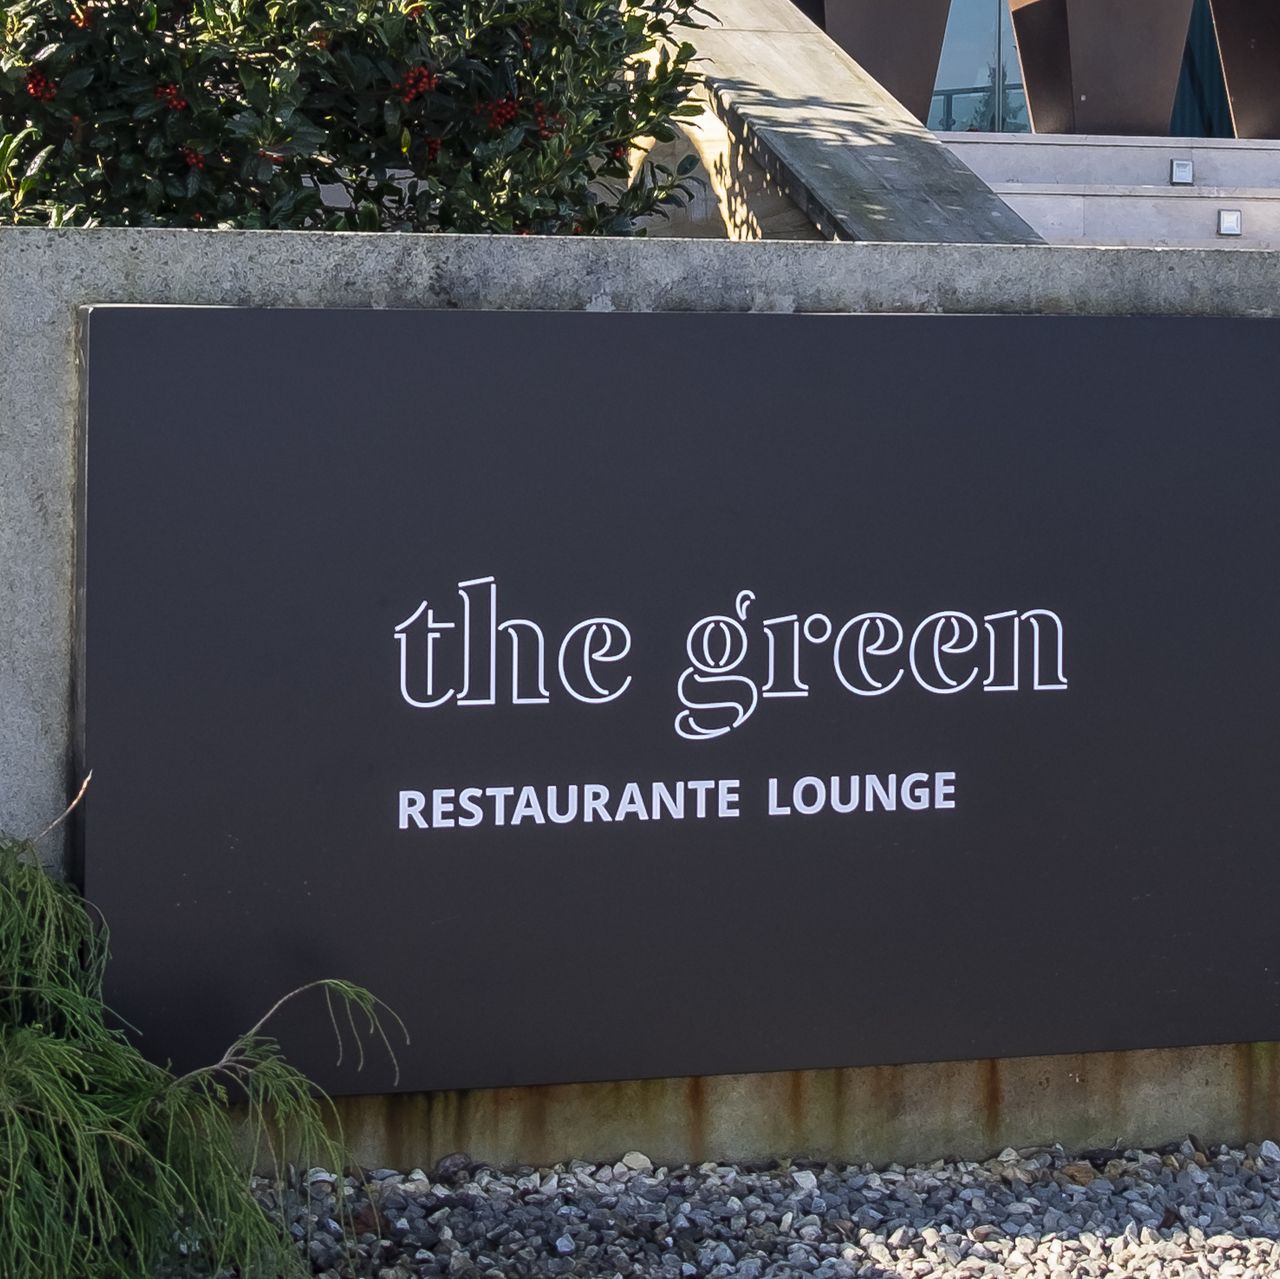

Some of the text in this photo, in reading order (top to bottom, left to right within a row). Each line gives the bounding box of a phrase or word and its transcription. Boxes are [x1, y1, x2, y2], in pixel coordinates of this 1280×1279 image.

[393, 575, 1068, 740] the green
[398, 771, 956, 830] RESTAURANTE LOUNGE
